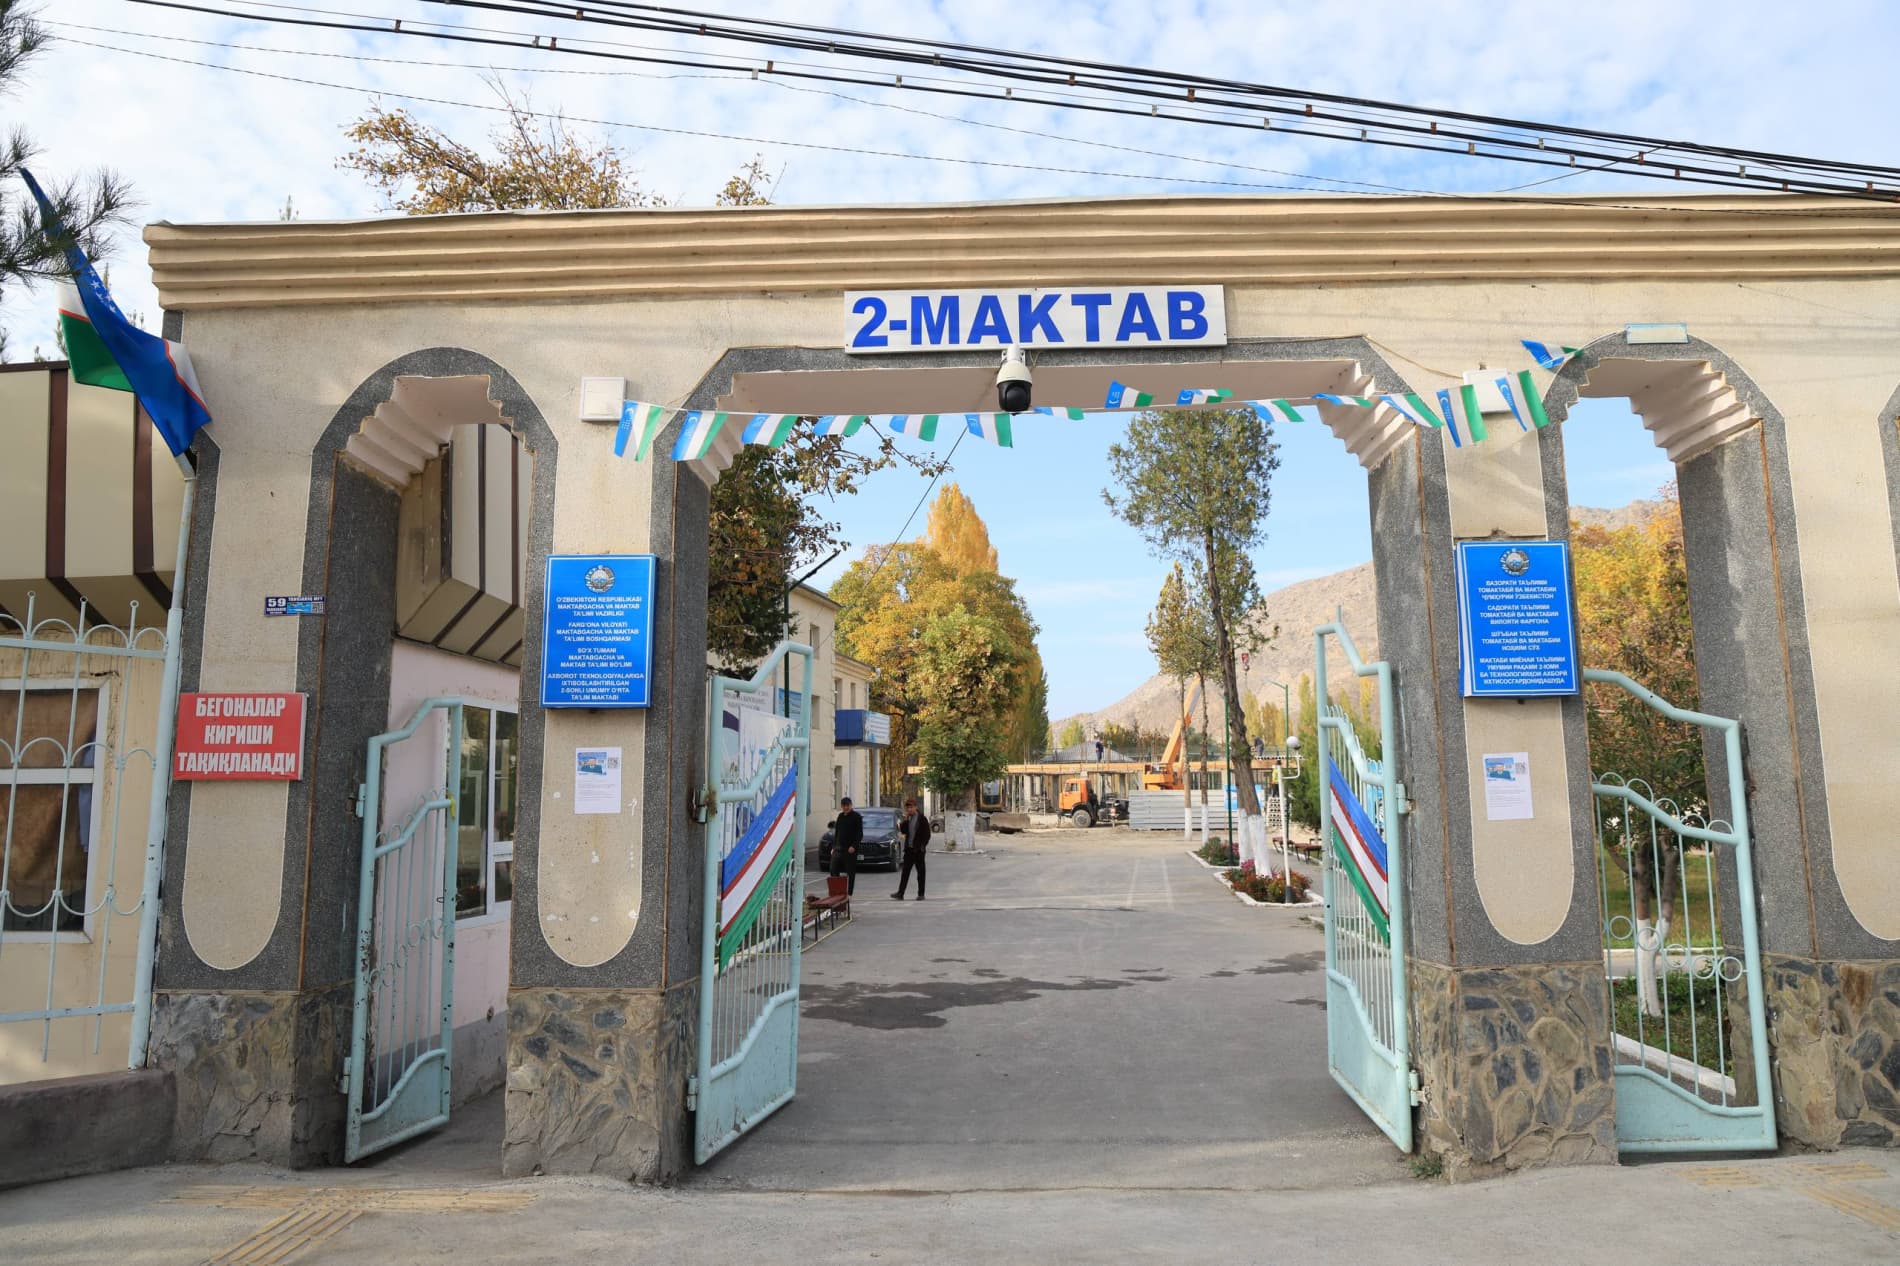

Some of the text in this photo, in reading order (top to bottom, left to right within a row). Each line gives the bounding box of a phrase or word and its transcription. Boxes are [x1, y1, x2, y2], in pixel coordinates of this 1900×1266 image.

[852, 291, 1209, 348] 2-MAKTAB
[267, 598, 286, 607] 59
[196, 698, 286, 717] БЕГОНАЛАР
[204, 725, 273, 744] КИРИШИ
[178, 752, 296, 775] ТАҚИҚЛАНАДИ
